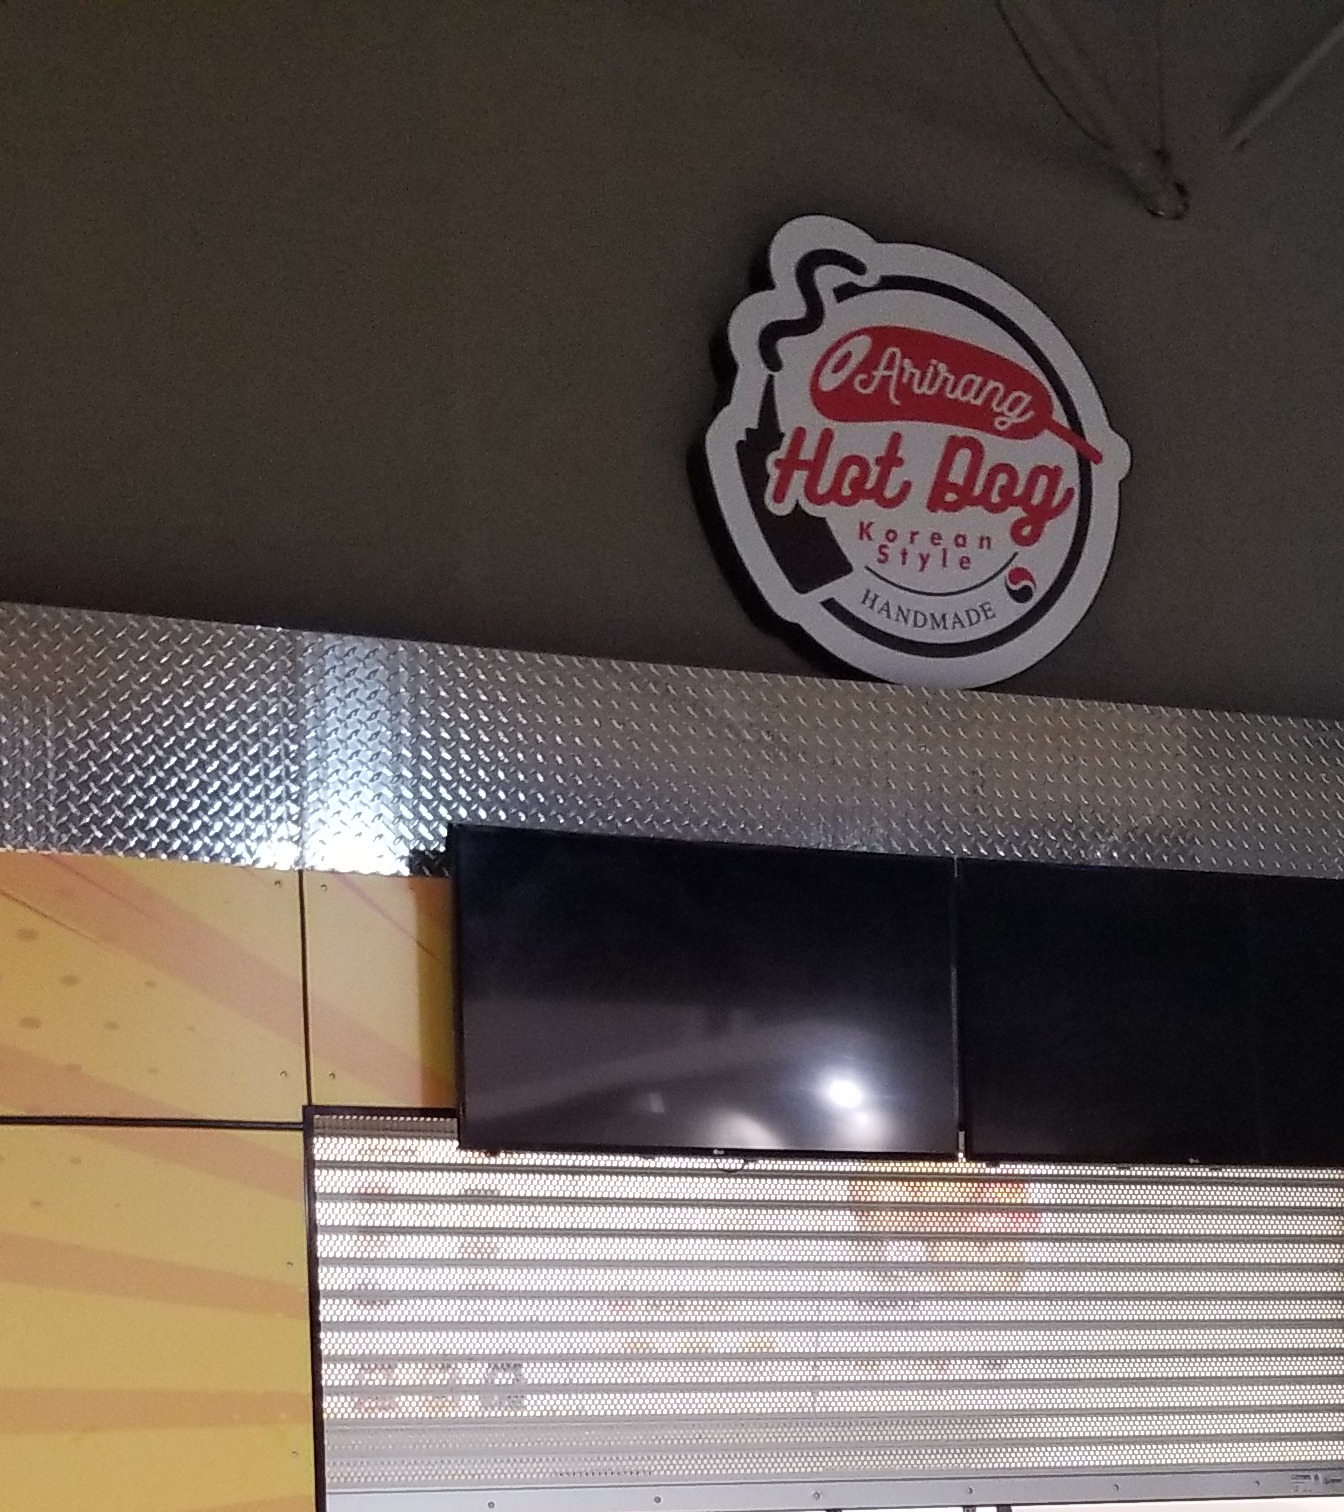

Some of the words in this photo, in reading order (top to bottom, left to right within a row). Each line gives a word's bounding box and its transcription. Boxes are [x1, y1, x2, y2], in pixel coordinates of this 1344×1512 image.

[855, 346, 1034, 429] Arirang
[770, 427, 913, 508] Hot
[926, 435, 1076, 547] Dog
[858, 520, 994, 551] Korean
[877, 544, 973, 572] Style
[859, 588, 997, 631] HANDMADE
